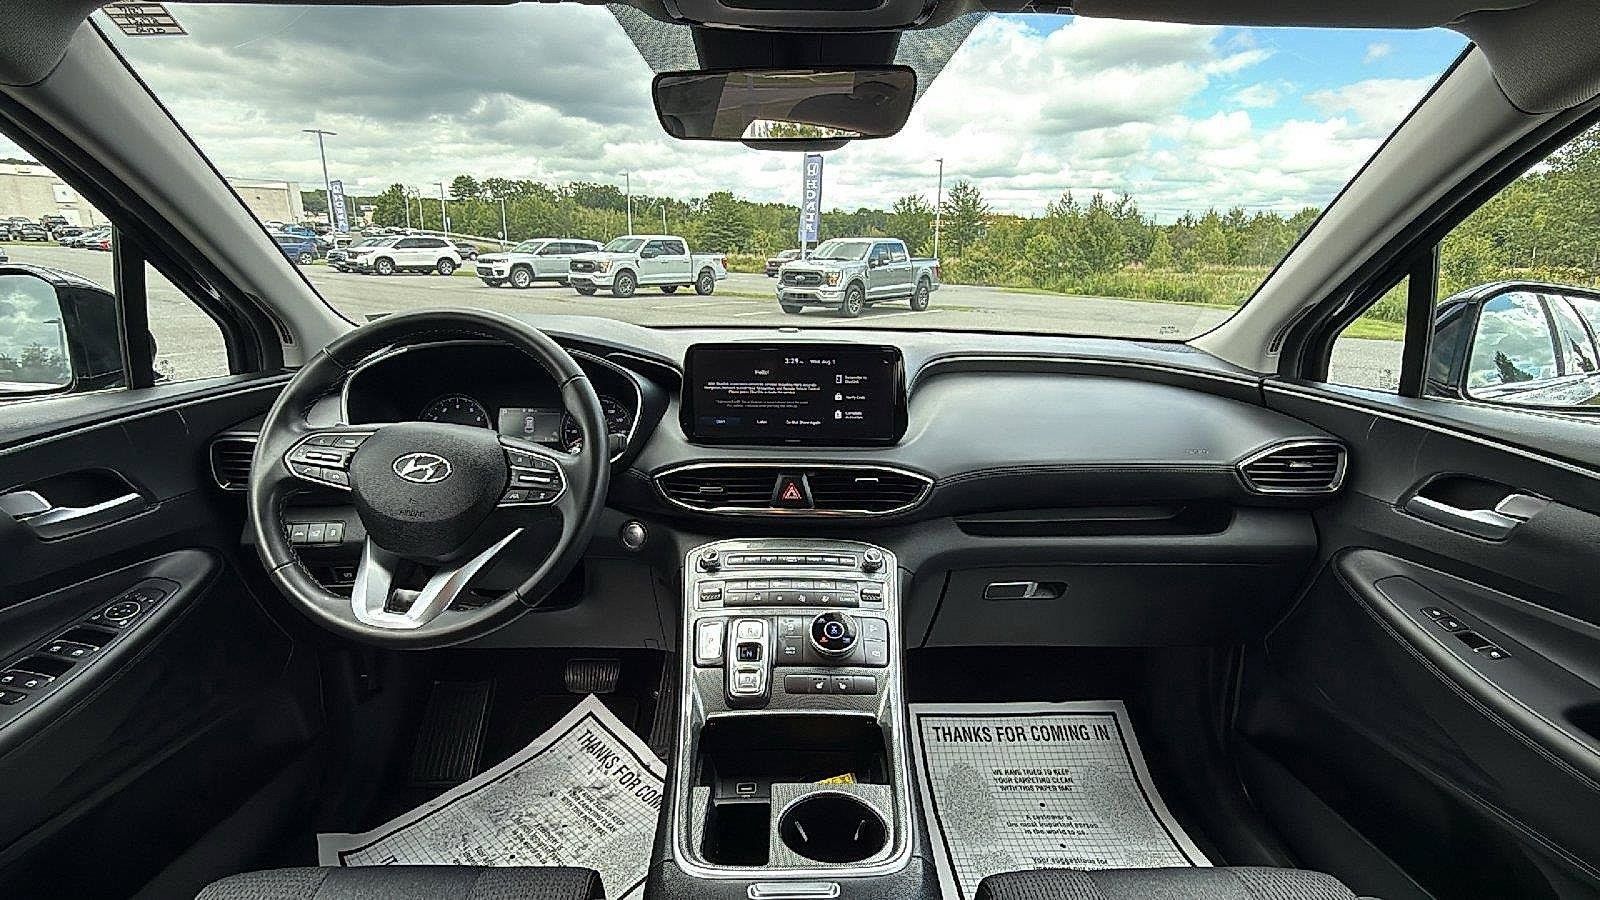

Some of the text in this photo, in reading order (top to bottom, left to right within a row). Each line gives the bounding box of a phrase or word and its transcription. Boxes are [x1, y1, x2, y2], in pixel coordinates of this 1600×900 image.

[932, 725, 1110, 743] THANKS FOR COMING IN
[578, 729, 620, 768] THANKS
[612, 765, 641, 791] FOR
